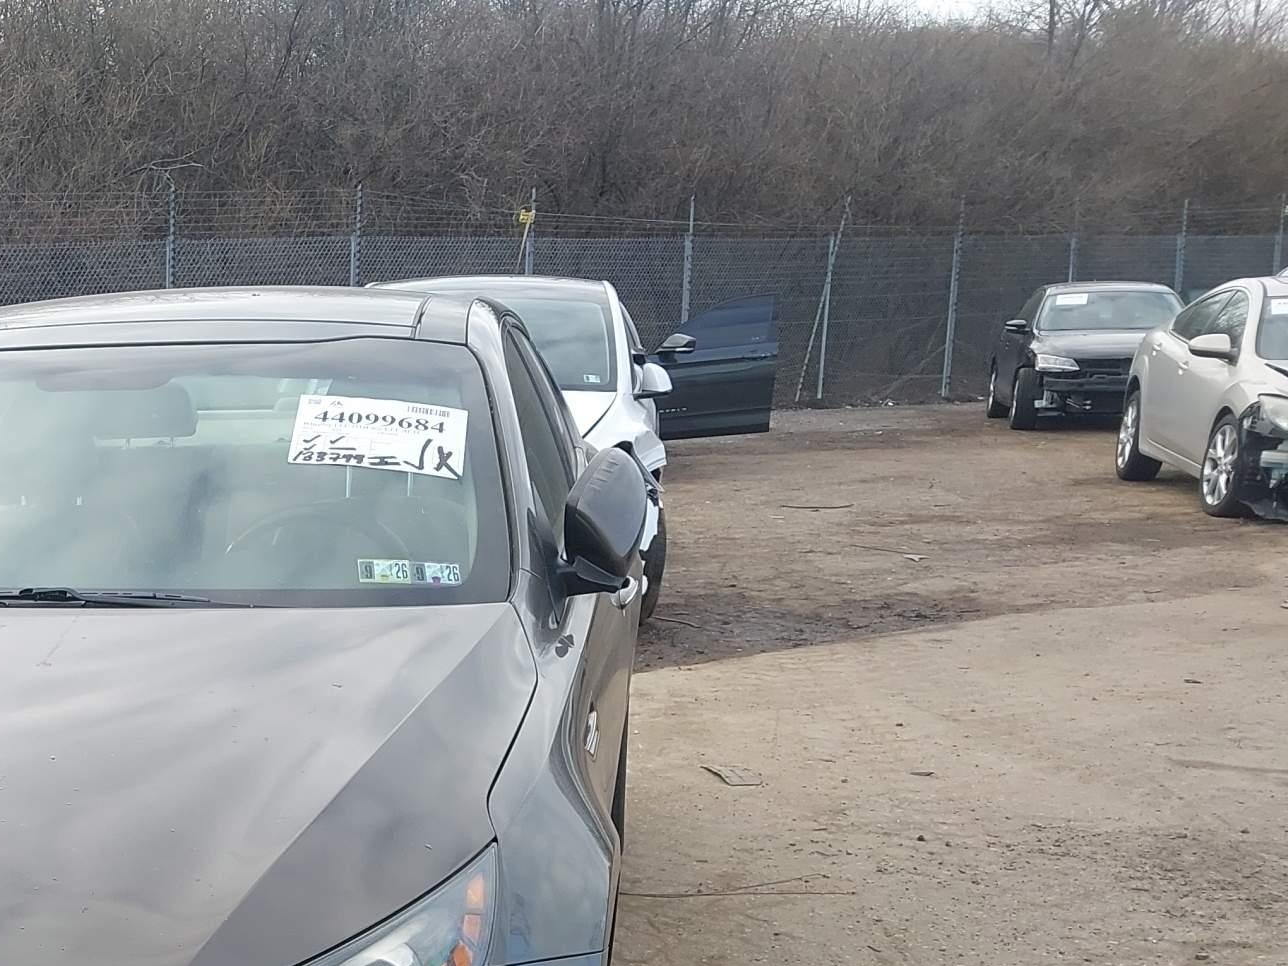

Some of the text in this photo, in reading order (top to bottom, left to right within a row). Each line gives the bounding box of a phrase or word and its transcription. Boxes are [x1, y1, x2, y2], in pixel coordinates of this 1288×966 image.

[314, 410, 446, 434] 44099684
[394, 562, 409, 580] 26
[445, 564, 461, 582] 26
